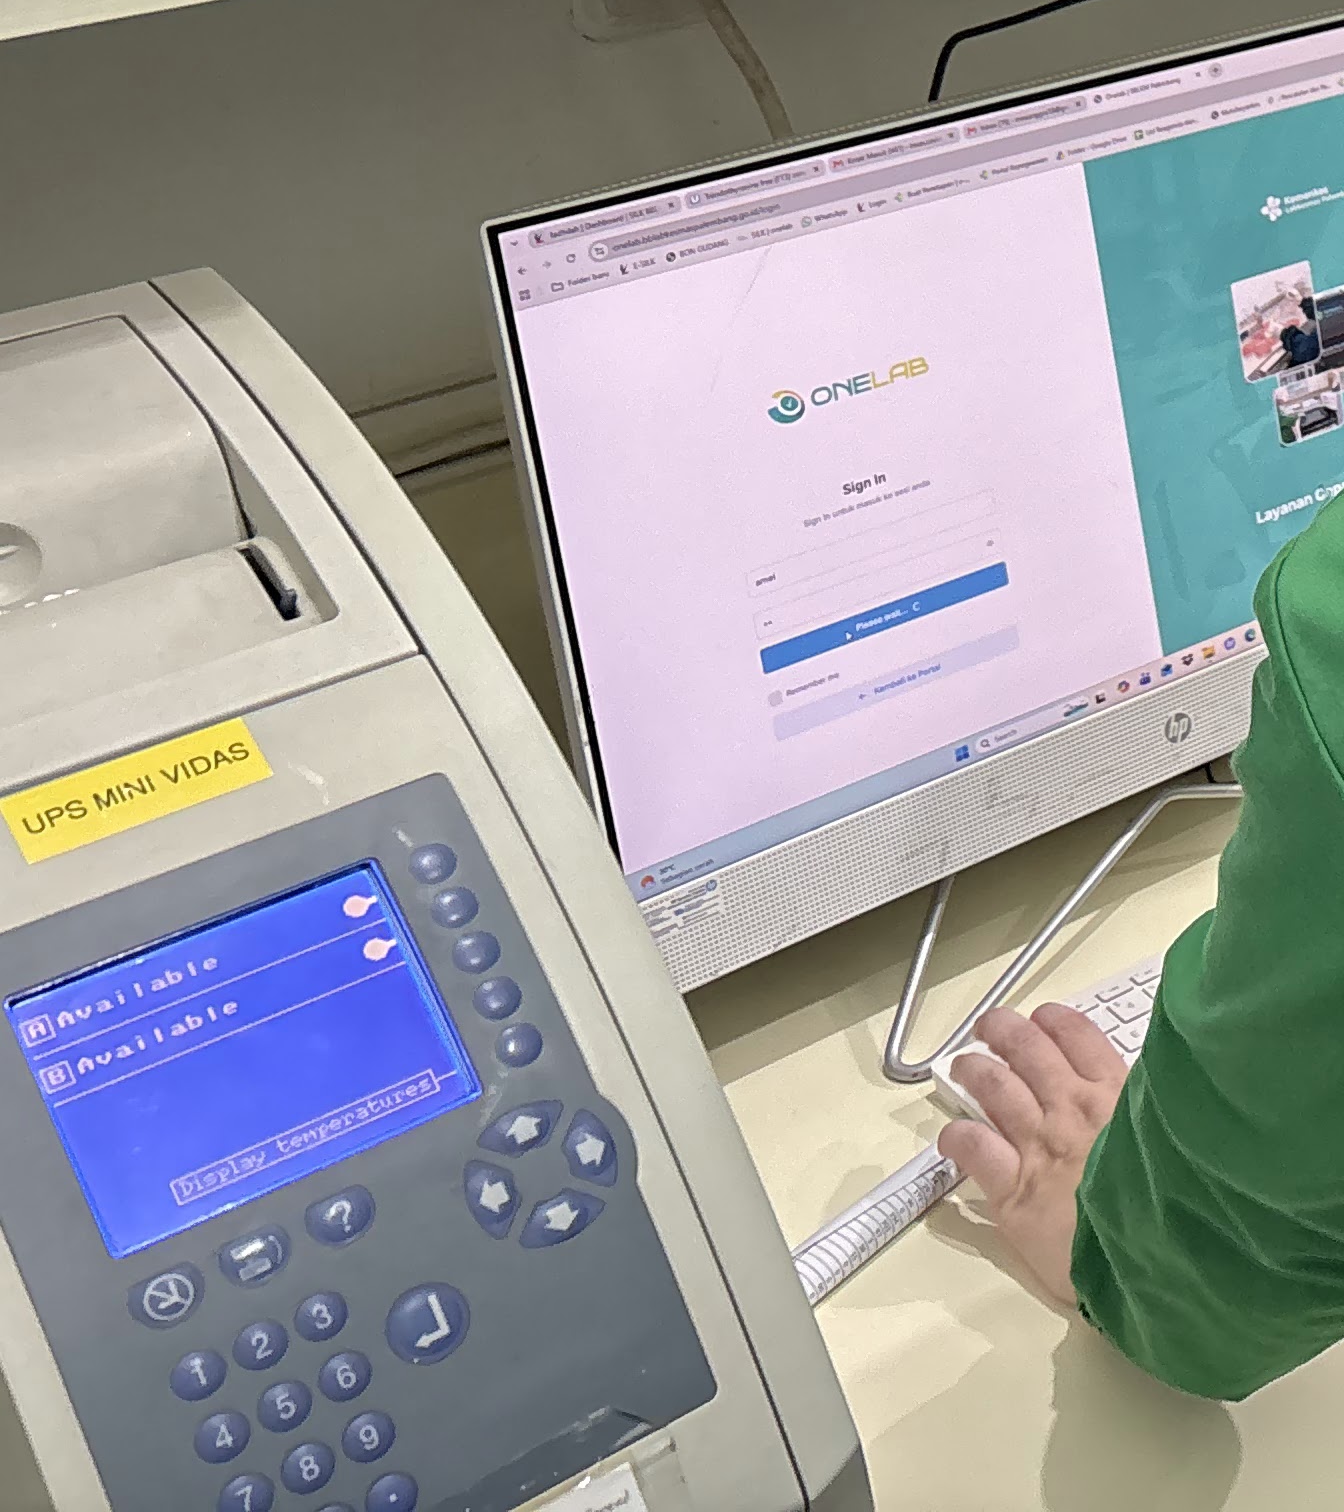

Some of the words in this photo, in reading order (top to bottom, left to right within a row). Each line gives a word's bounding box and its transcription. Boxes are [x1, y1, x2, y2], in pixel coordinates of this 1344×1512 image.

[810, 356, 930, 407] ONELAB
[842, 478, 872, 497] Sign
[873, 473, 887, 486] In
[1256, 494, 1314, 525] Layanan
[855, 615, 884, 633] Please
[1165, 712, 1192, 744] hp
[22, 799, 87, 835] UPS
[92, 774, 156, 812] MINI
[159, 742, 250, 785] VIDAS
[57, 957, 218, 1029] Available
[77, 1001, 238, 1075] Available
[179, 1149, 266, 1199] Display
[276, 1076, 432, 1154] temperatures
[311, 1302, 334, 1330] 3
[250, 1331, 274, 1360] 2
[189, 1356, 208, 1387] 1
[335, 1364, 357, 1390] 6
[275, 1393, 297, 1421] 5
[215, 1422, 234, 1449] 4
[358, 1424, 380, 1451] 9
[299, 1455, 321, 1482] 8
[234, 1485, 253, 1512] 7
